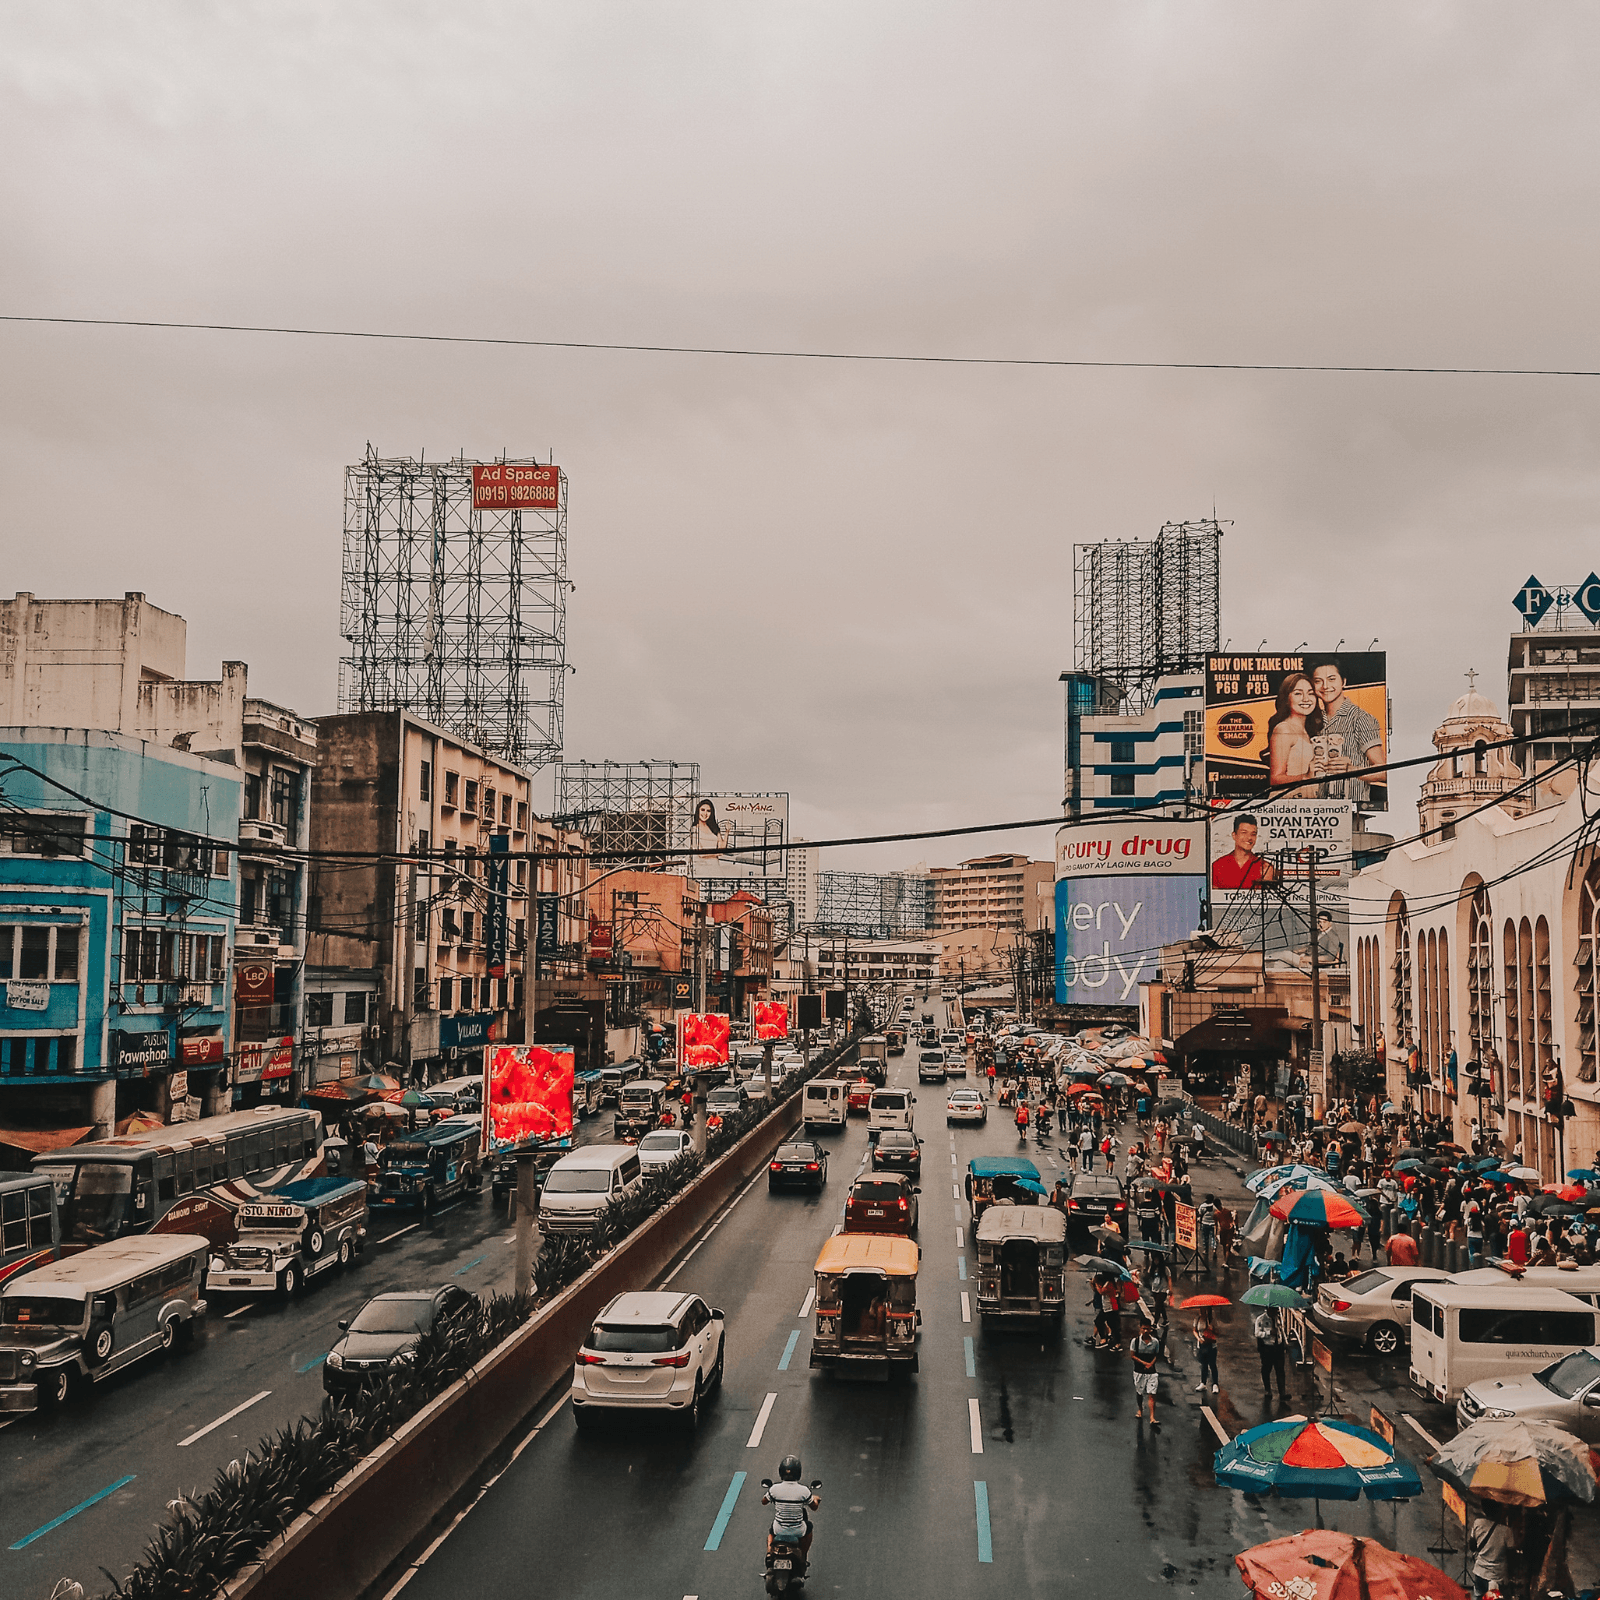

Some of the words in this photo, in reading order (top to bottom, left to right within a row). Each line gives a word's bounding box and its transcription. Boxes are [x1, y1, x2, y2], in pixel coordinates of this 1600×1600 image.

[480, 468, 501, 480] Ad
[505, 468, 551, 483] Space
[476, 485, 507, 505] (0915)
[510, 485, 556, 500] 9826888
[1521, 587, 1547, 615] F
[1556, 593, 1571, 606] &
[1209, 657, 1232, 671] BUY
[1233, 657, 1254, 671] ONE
[1255, 657, 1282, 671] TAKE
[1282, 657, 1304, 671] ONE
[1313, 805, 1349, 816] gamot?
[1260, 816, 1302, 827] DIYAN
[1304, 816, 1339, 827] TAYO
[1269, 828, 1287, 839] SA
[1288, 828, 1333, 839] TAPAT!
[1121, 835, 1192, 860] drug
[1072, 862, 1095, 871] GAMOT
[1143, 860, 1172, 868] BAGO
[245, 972, 265, 981] LBC
[143, 1034, 168, 1047] RUSLIN
[119, 1047, 167, 1065] Pawnshop
[167, 1207, 190, 1222] DIAMOND
[245, 1205, 264, 1215] STO.
